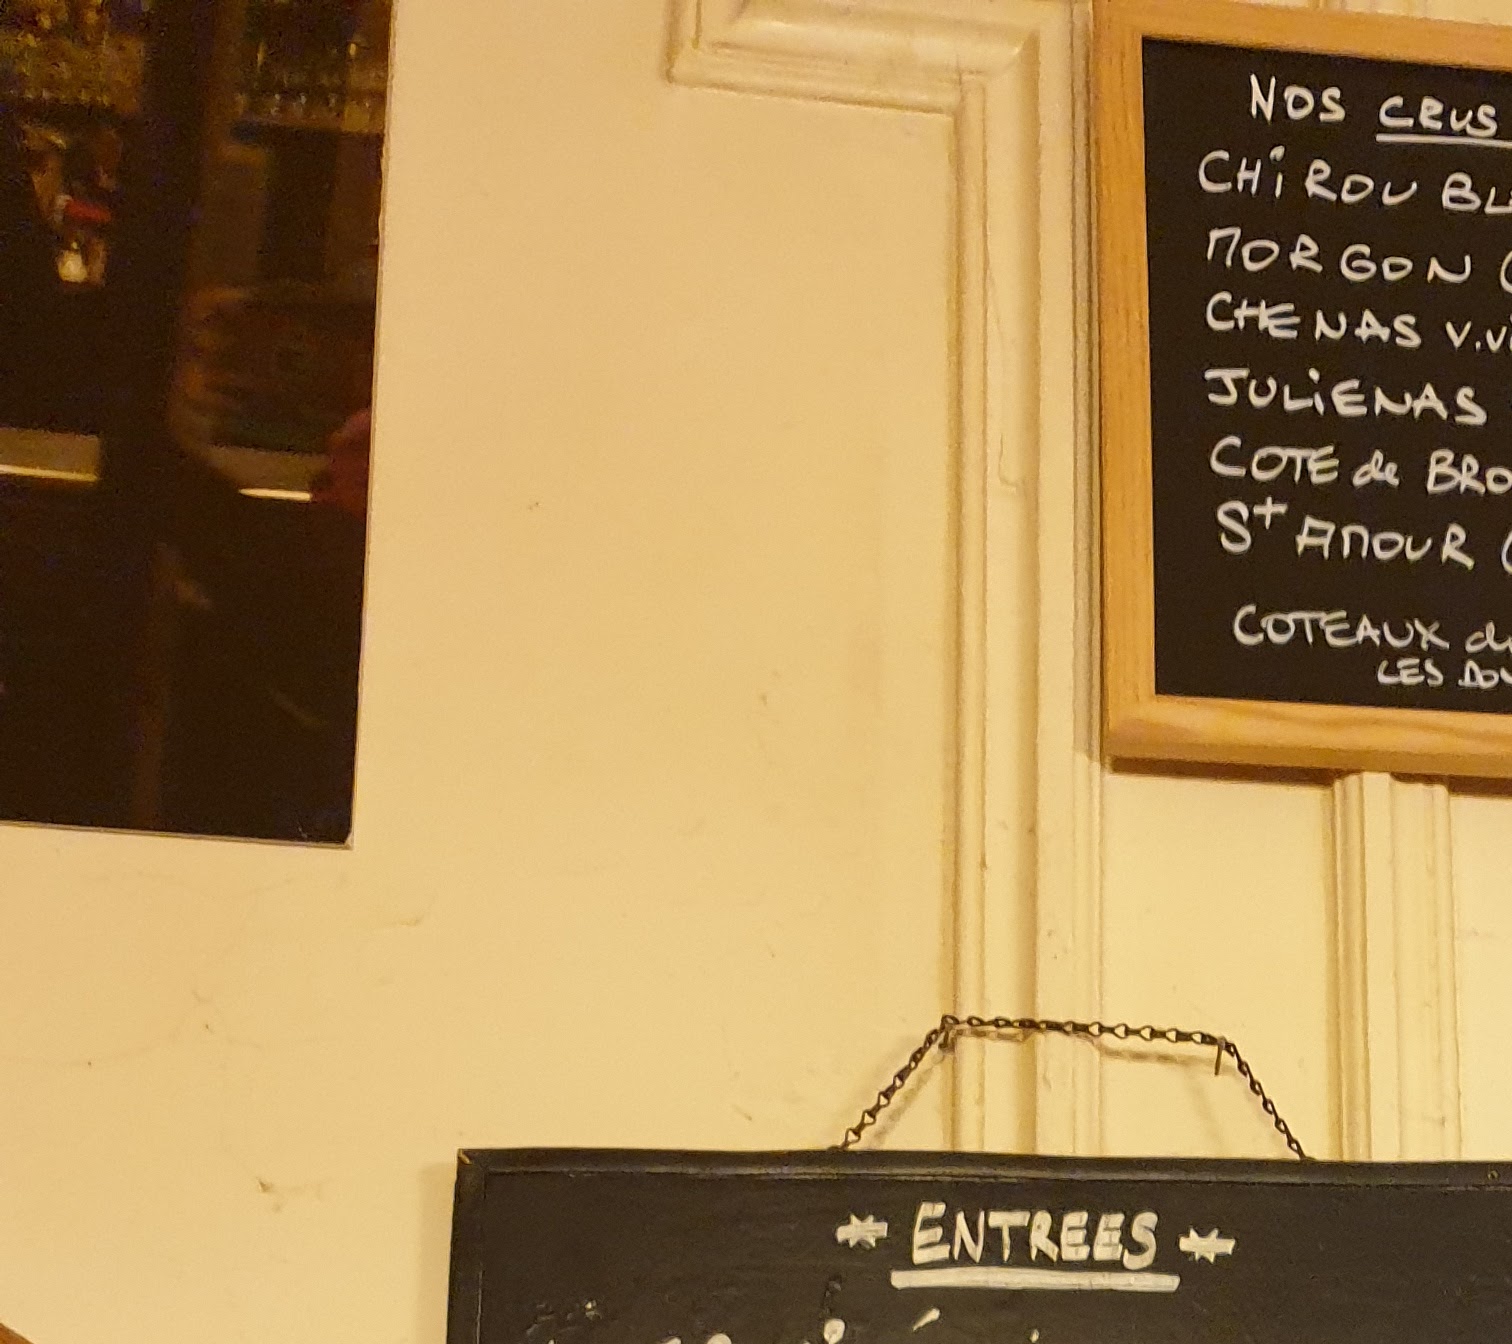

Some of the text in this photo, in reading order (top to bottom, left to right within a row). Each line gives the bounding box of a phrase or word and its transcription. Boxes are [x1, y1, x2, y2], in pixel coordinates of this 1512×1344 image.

[1250, 74, 1496, 138] NOS CRUS
[1206, 228, 1472, 283] MORGON
[1211, 441, 1340, 484] COTE
[1298, 516, 1473, 570] AMOUR
[1232, 607, 1449, 653] COTEAUX
[1379, 661, 1444, 685] LES
[912, 1203, 1157, 1274] ENTREES
